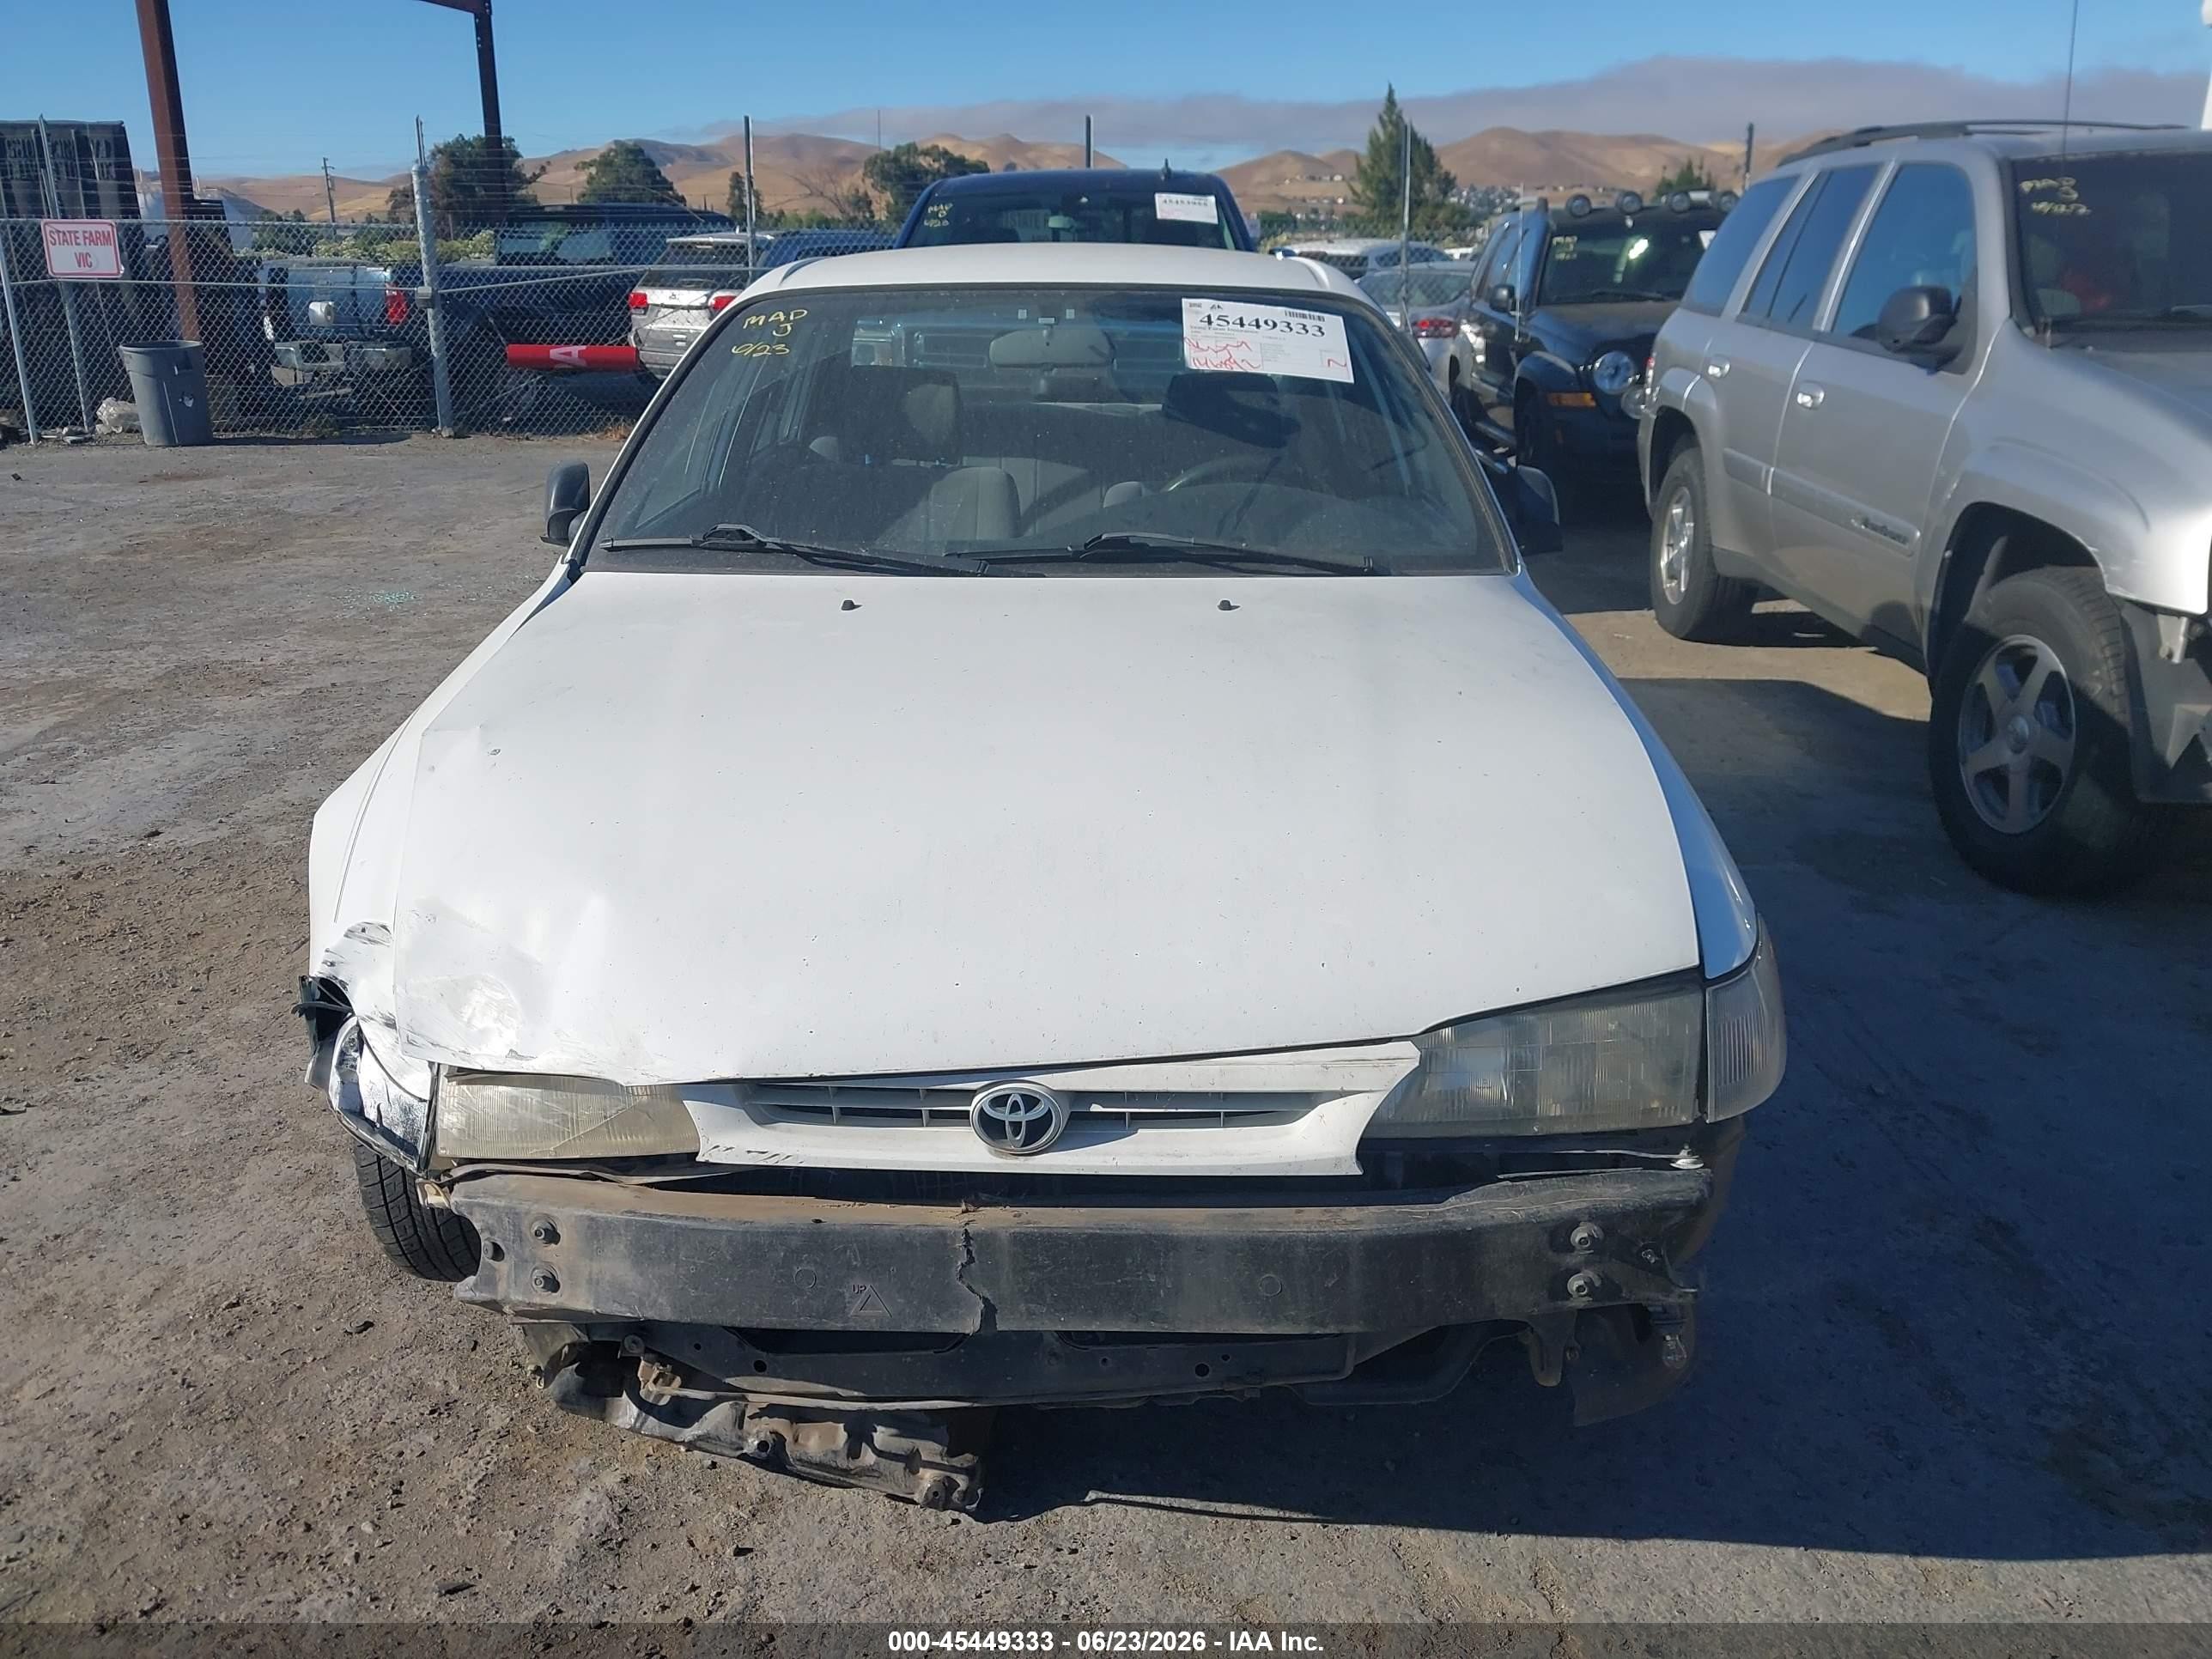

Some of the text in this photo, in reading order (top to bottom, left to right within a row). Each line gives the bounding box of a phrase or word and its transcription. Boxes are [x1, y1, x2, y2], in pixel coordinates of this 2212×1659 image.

[49, 229, 112, 246] STATE FARM
[74, 251, 93, 269] VIC
[1199, 313, 1325, 337] 45449333
[853, 1284, 867, 1295] UP
